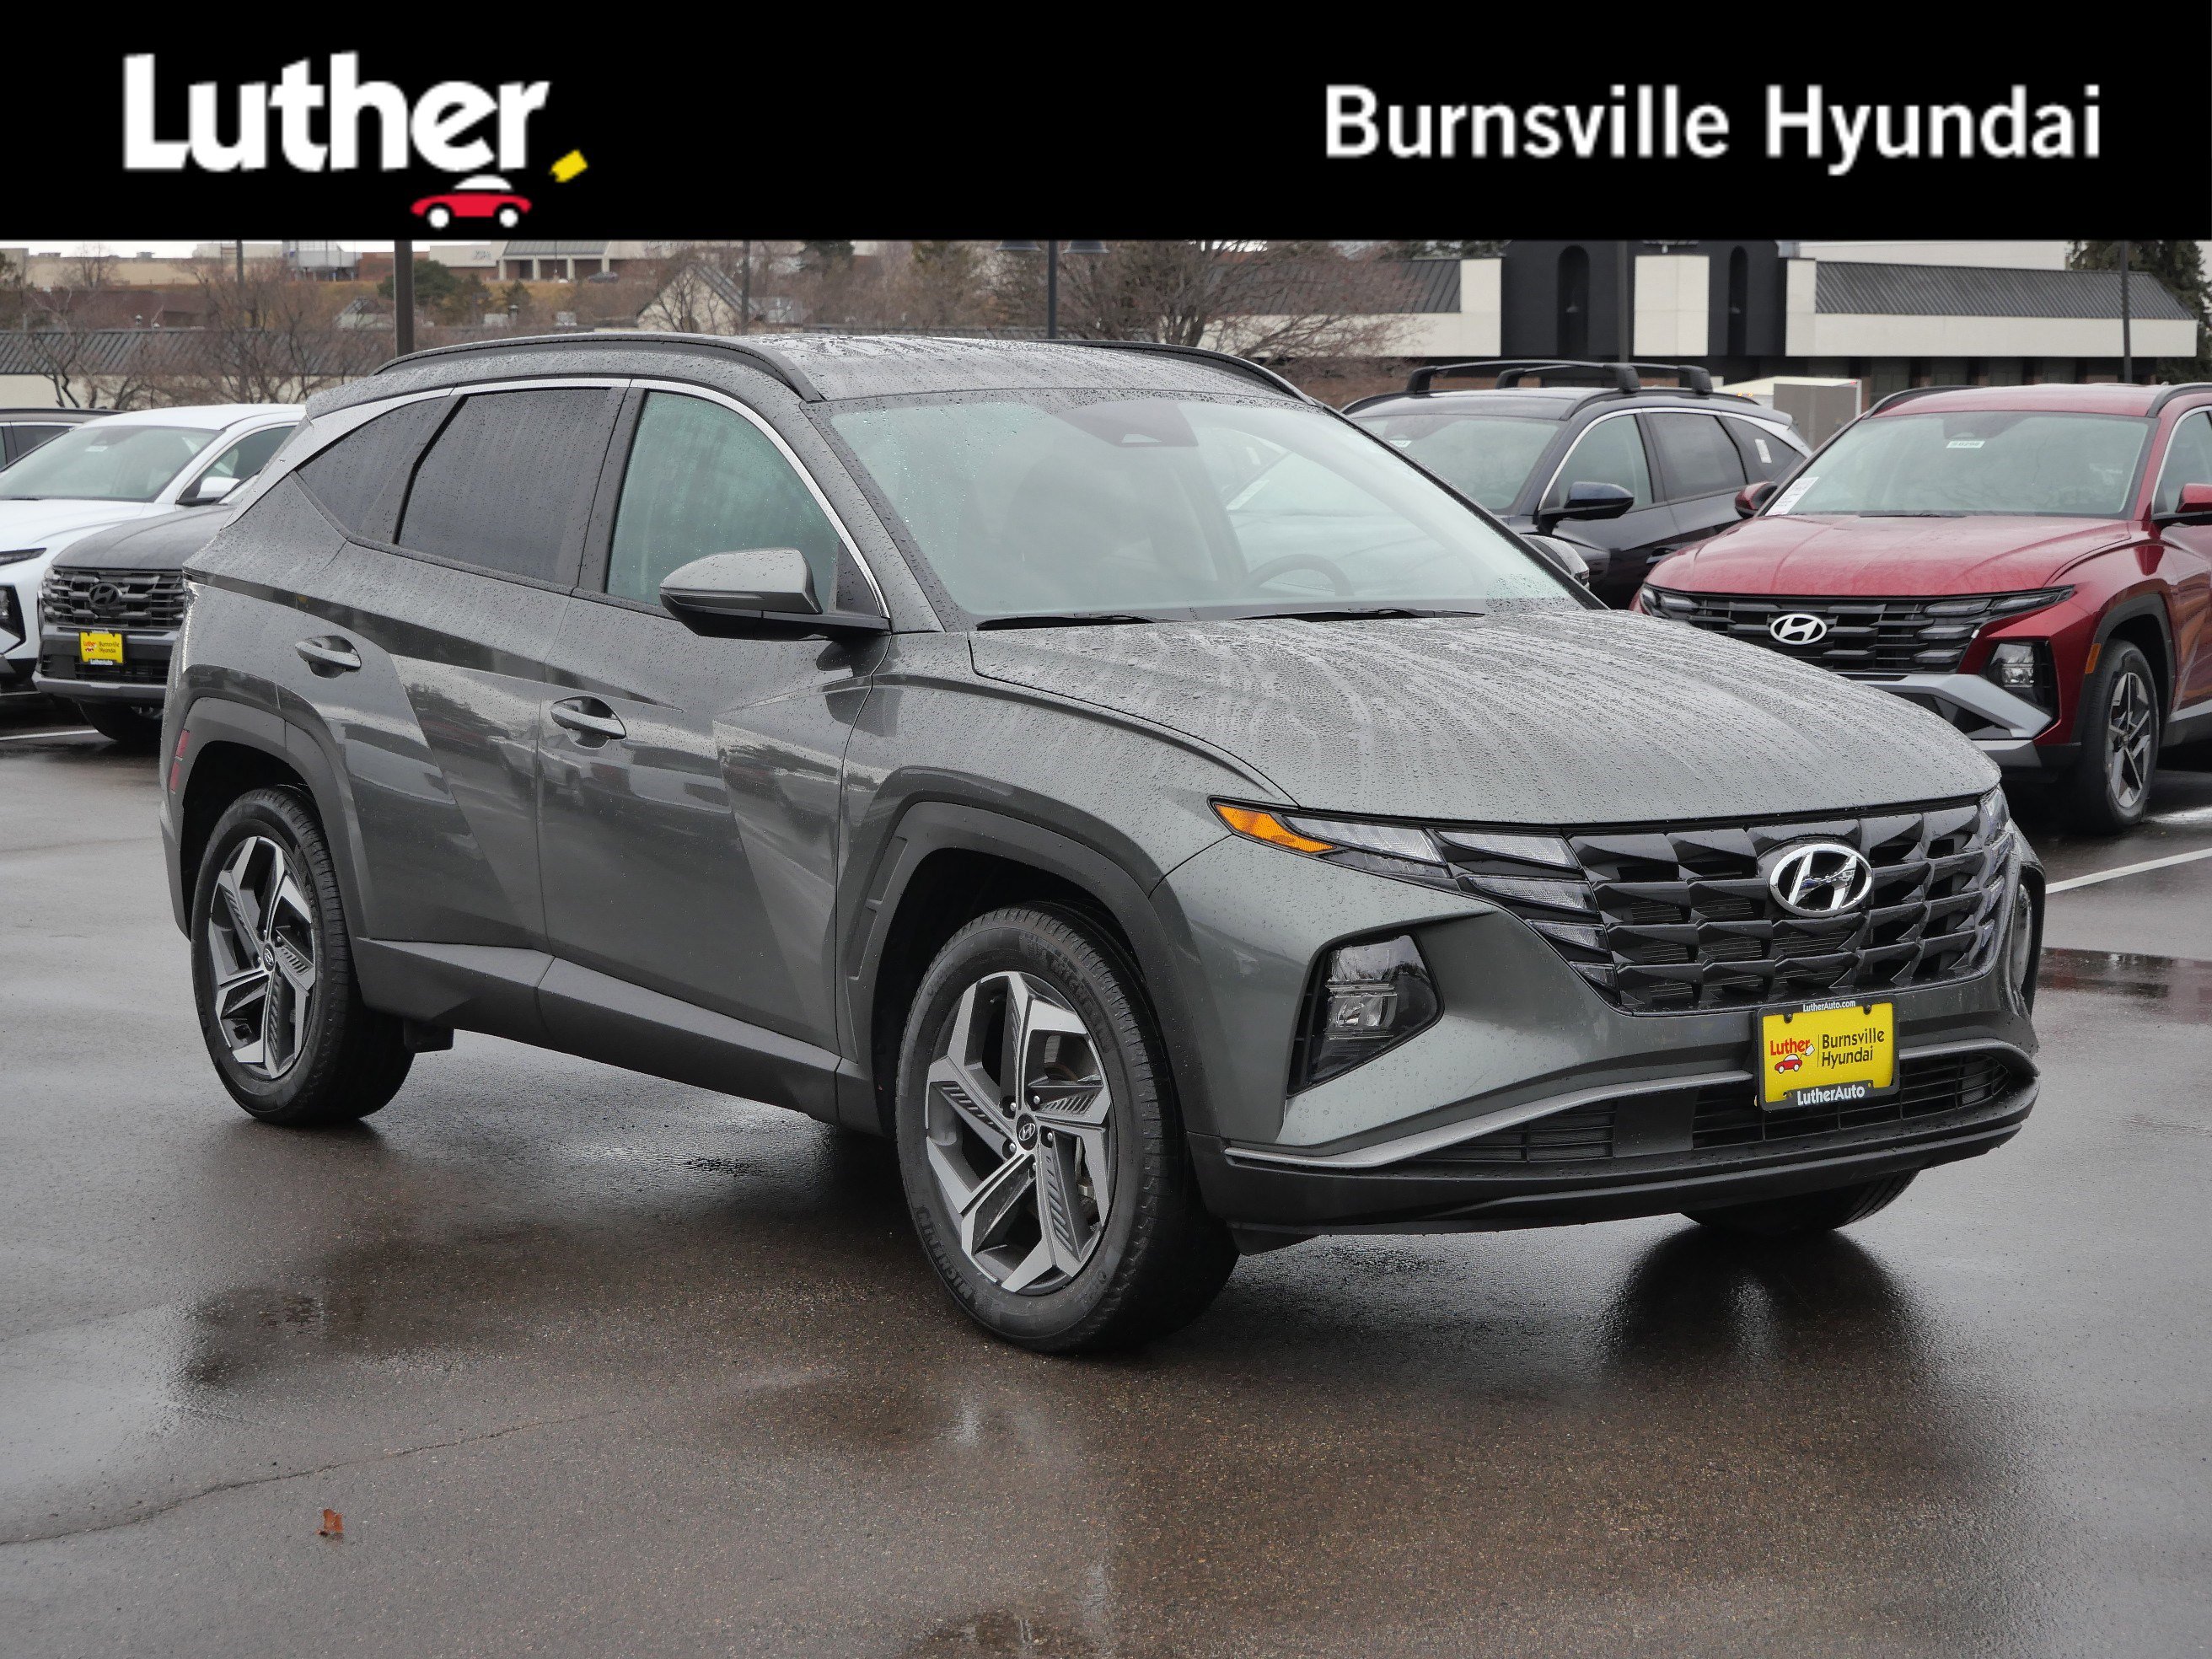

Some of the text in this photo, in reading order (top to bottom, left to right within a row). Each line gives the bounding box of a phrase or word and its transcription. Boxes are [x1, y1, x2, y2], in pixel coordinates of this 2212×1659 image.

[1802, 1001, 1856, 1012] LutherAuto.com
[1770, 1038, 1811, 1056] Luther
[1822, 1028, 1885, 1050] Burnsville
[1822, 1046, 1873, 1069] Hyundai
[1796, 1085, 1866, 1106] LutherAuto
